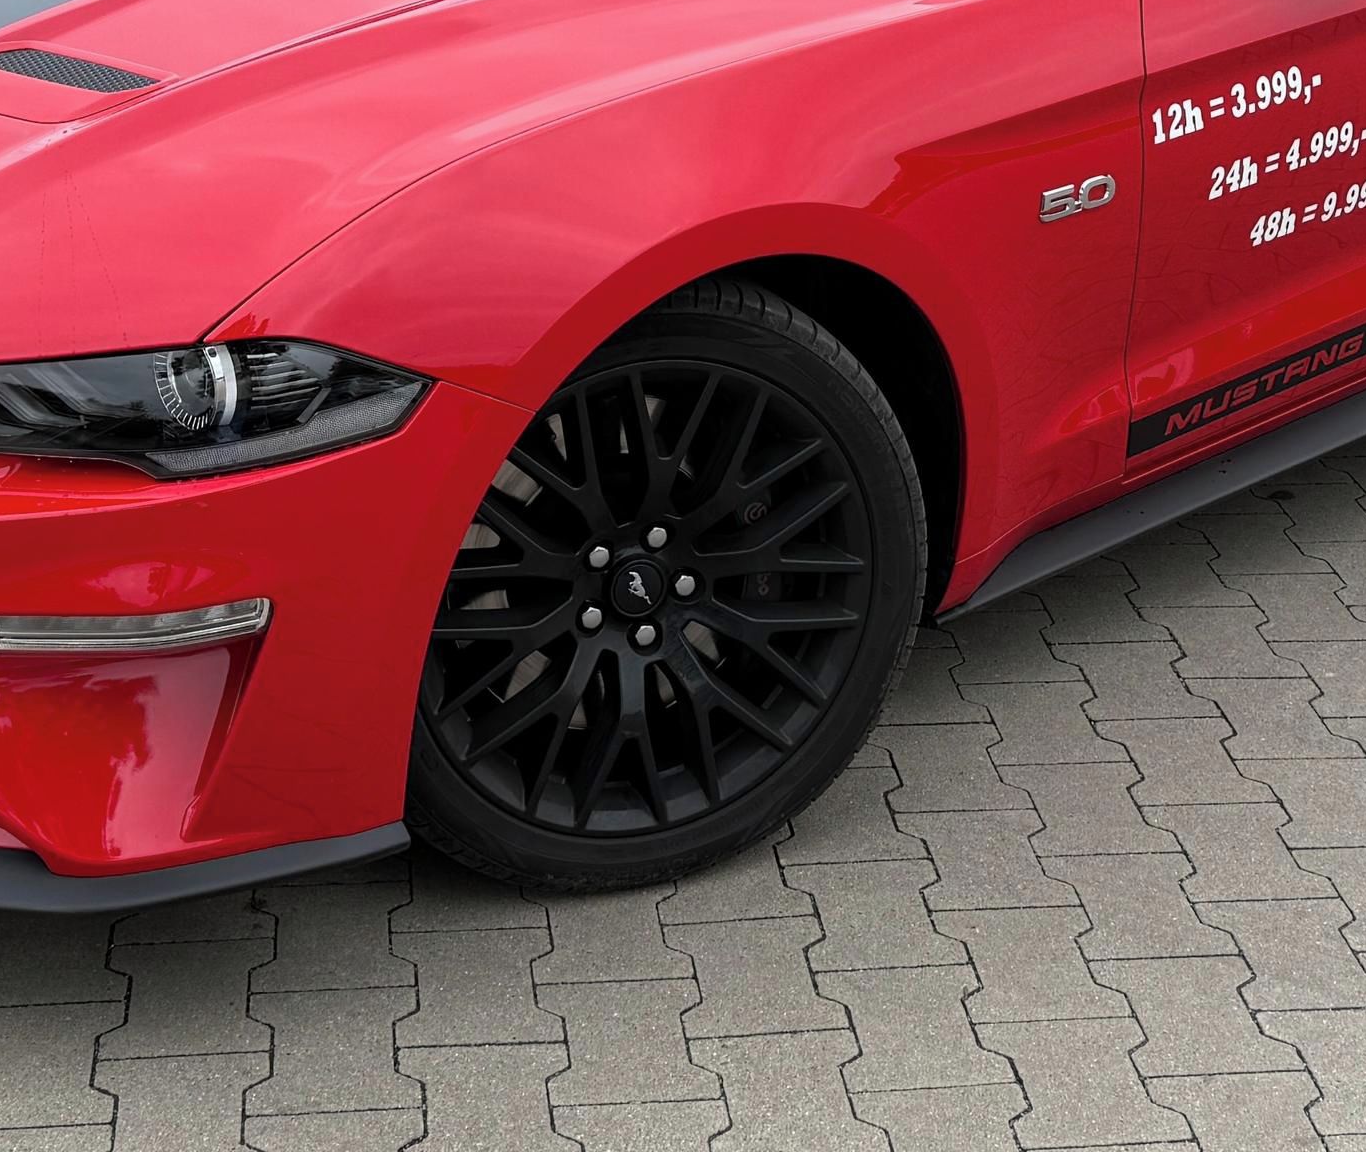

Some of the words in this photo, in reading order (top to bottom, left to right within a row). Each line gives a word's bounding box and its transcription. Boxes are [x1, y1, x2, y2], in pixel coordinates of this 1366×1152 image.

[1151, 103, 1204, 146] 12h
[1210, 96, 1226, 119] =
[1231, 65, 1322, 119] 3.999,-
[1209, 155, 1259, 200] 24h
[1265, 151, 1282, 174] =
[1249, 206, 1297, 248] 48h
[1301, 201, 1318, 225] =
[1163, 332, 1366, 436] MUSTANG
